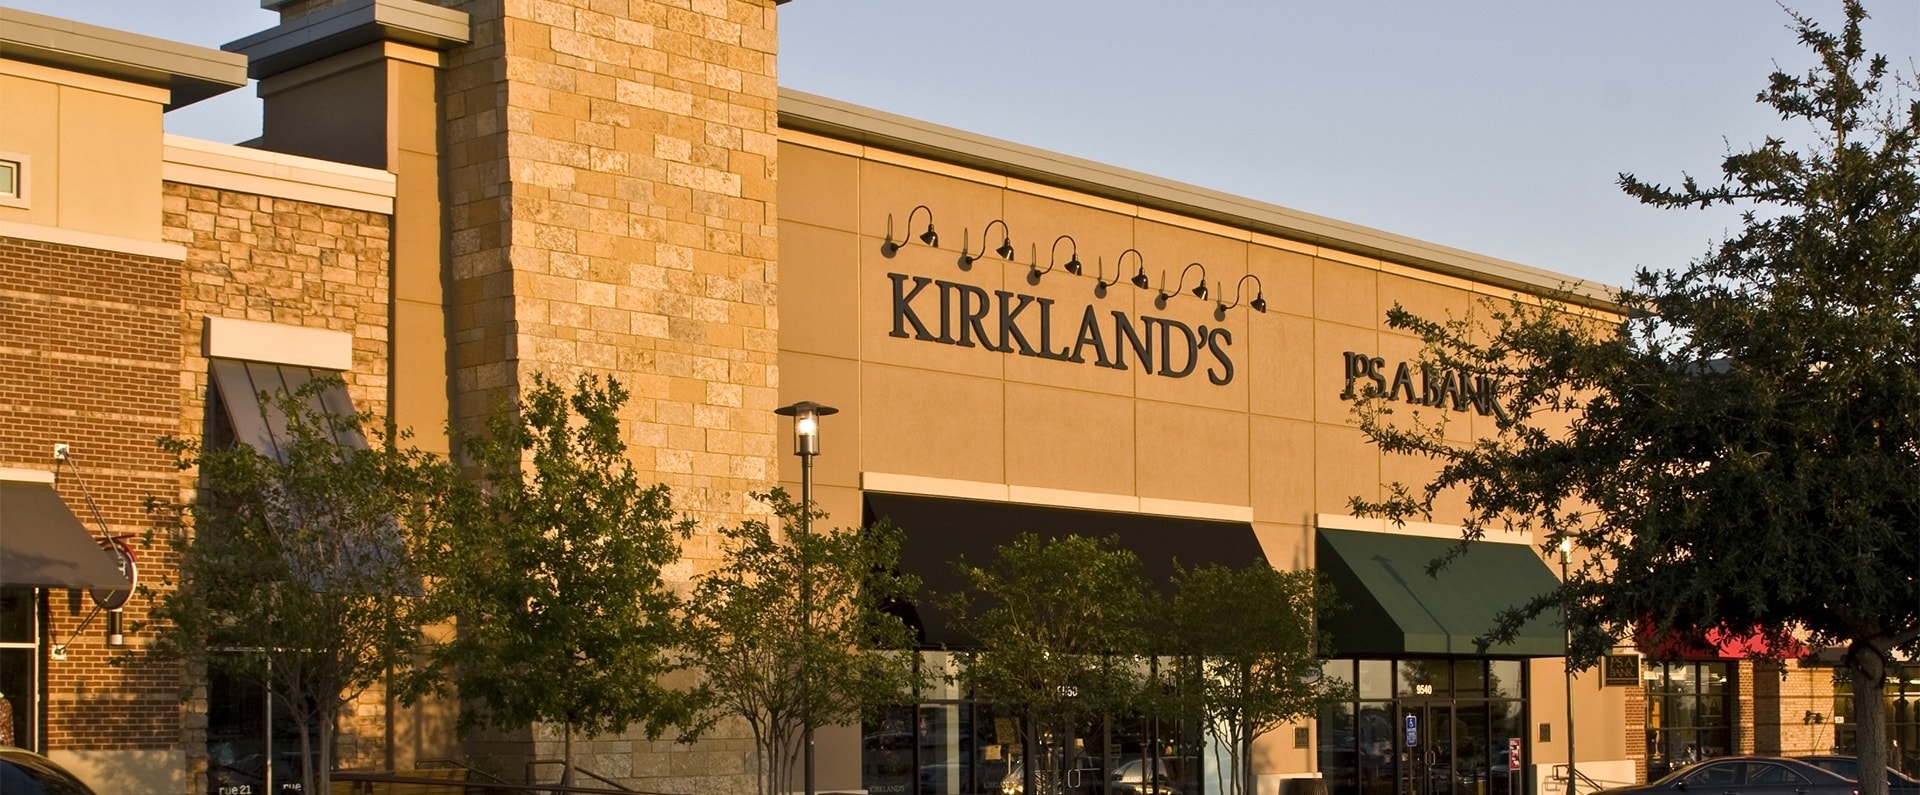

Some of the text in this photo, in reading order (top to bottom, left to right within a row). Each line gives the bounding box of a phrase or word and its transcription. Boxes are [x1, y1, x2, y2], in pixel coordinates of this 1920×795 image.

[887, 272, 1234, 386] KIRKLAND'S
[1416, 684, 1433, 695] 9540
[218, 784, 252, 795] rue 21
